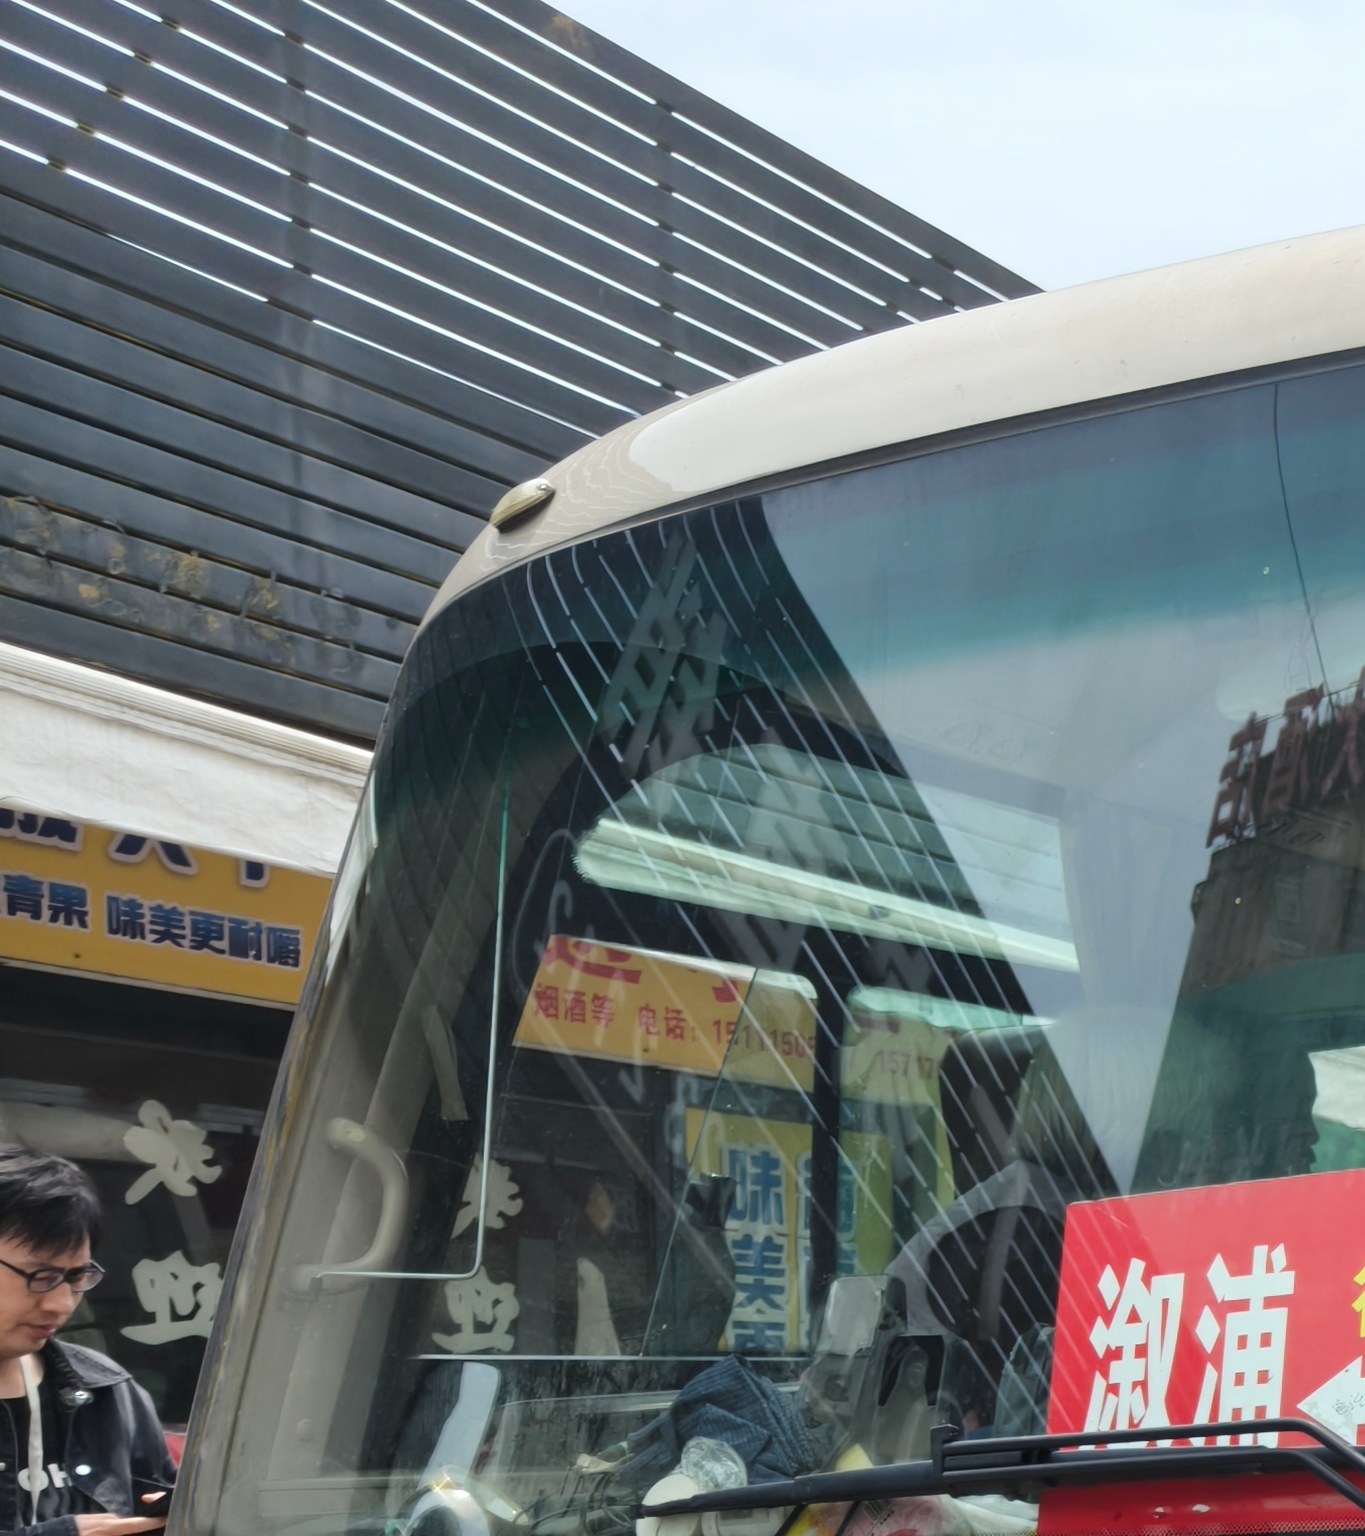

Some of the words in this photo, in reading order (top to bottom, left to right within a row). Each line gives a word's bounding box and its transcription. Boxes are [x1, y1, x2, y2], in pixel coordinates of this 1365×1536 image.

[106, 894, 301, 968] 味美更耐嚼
